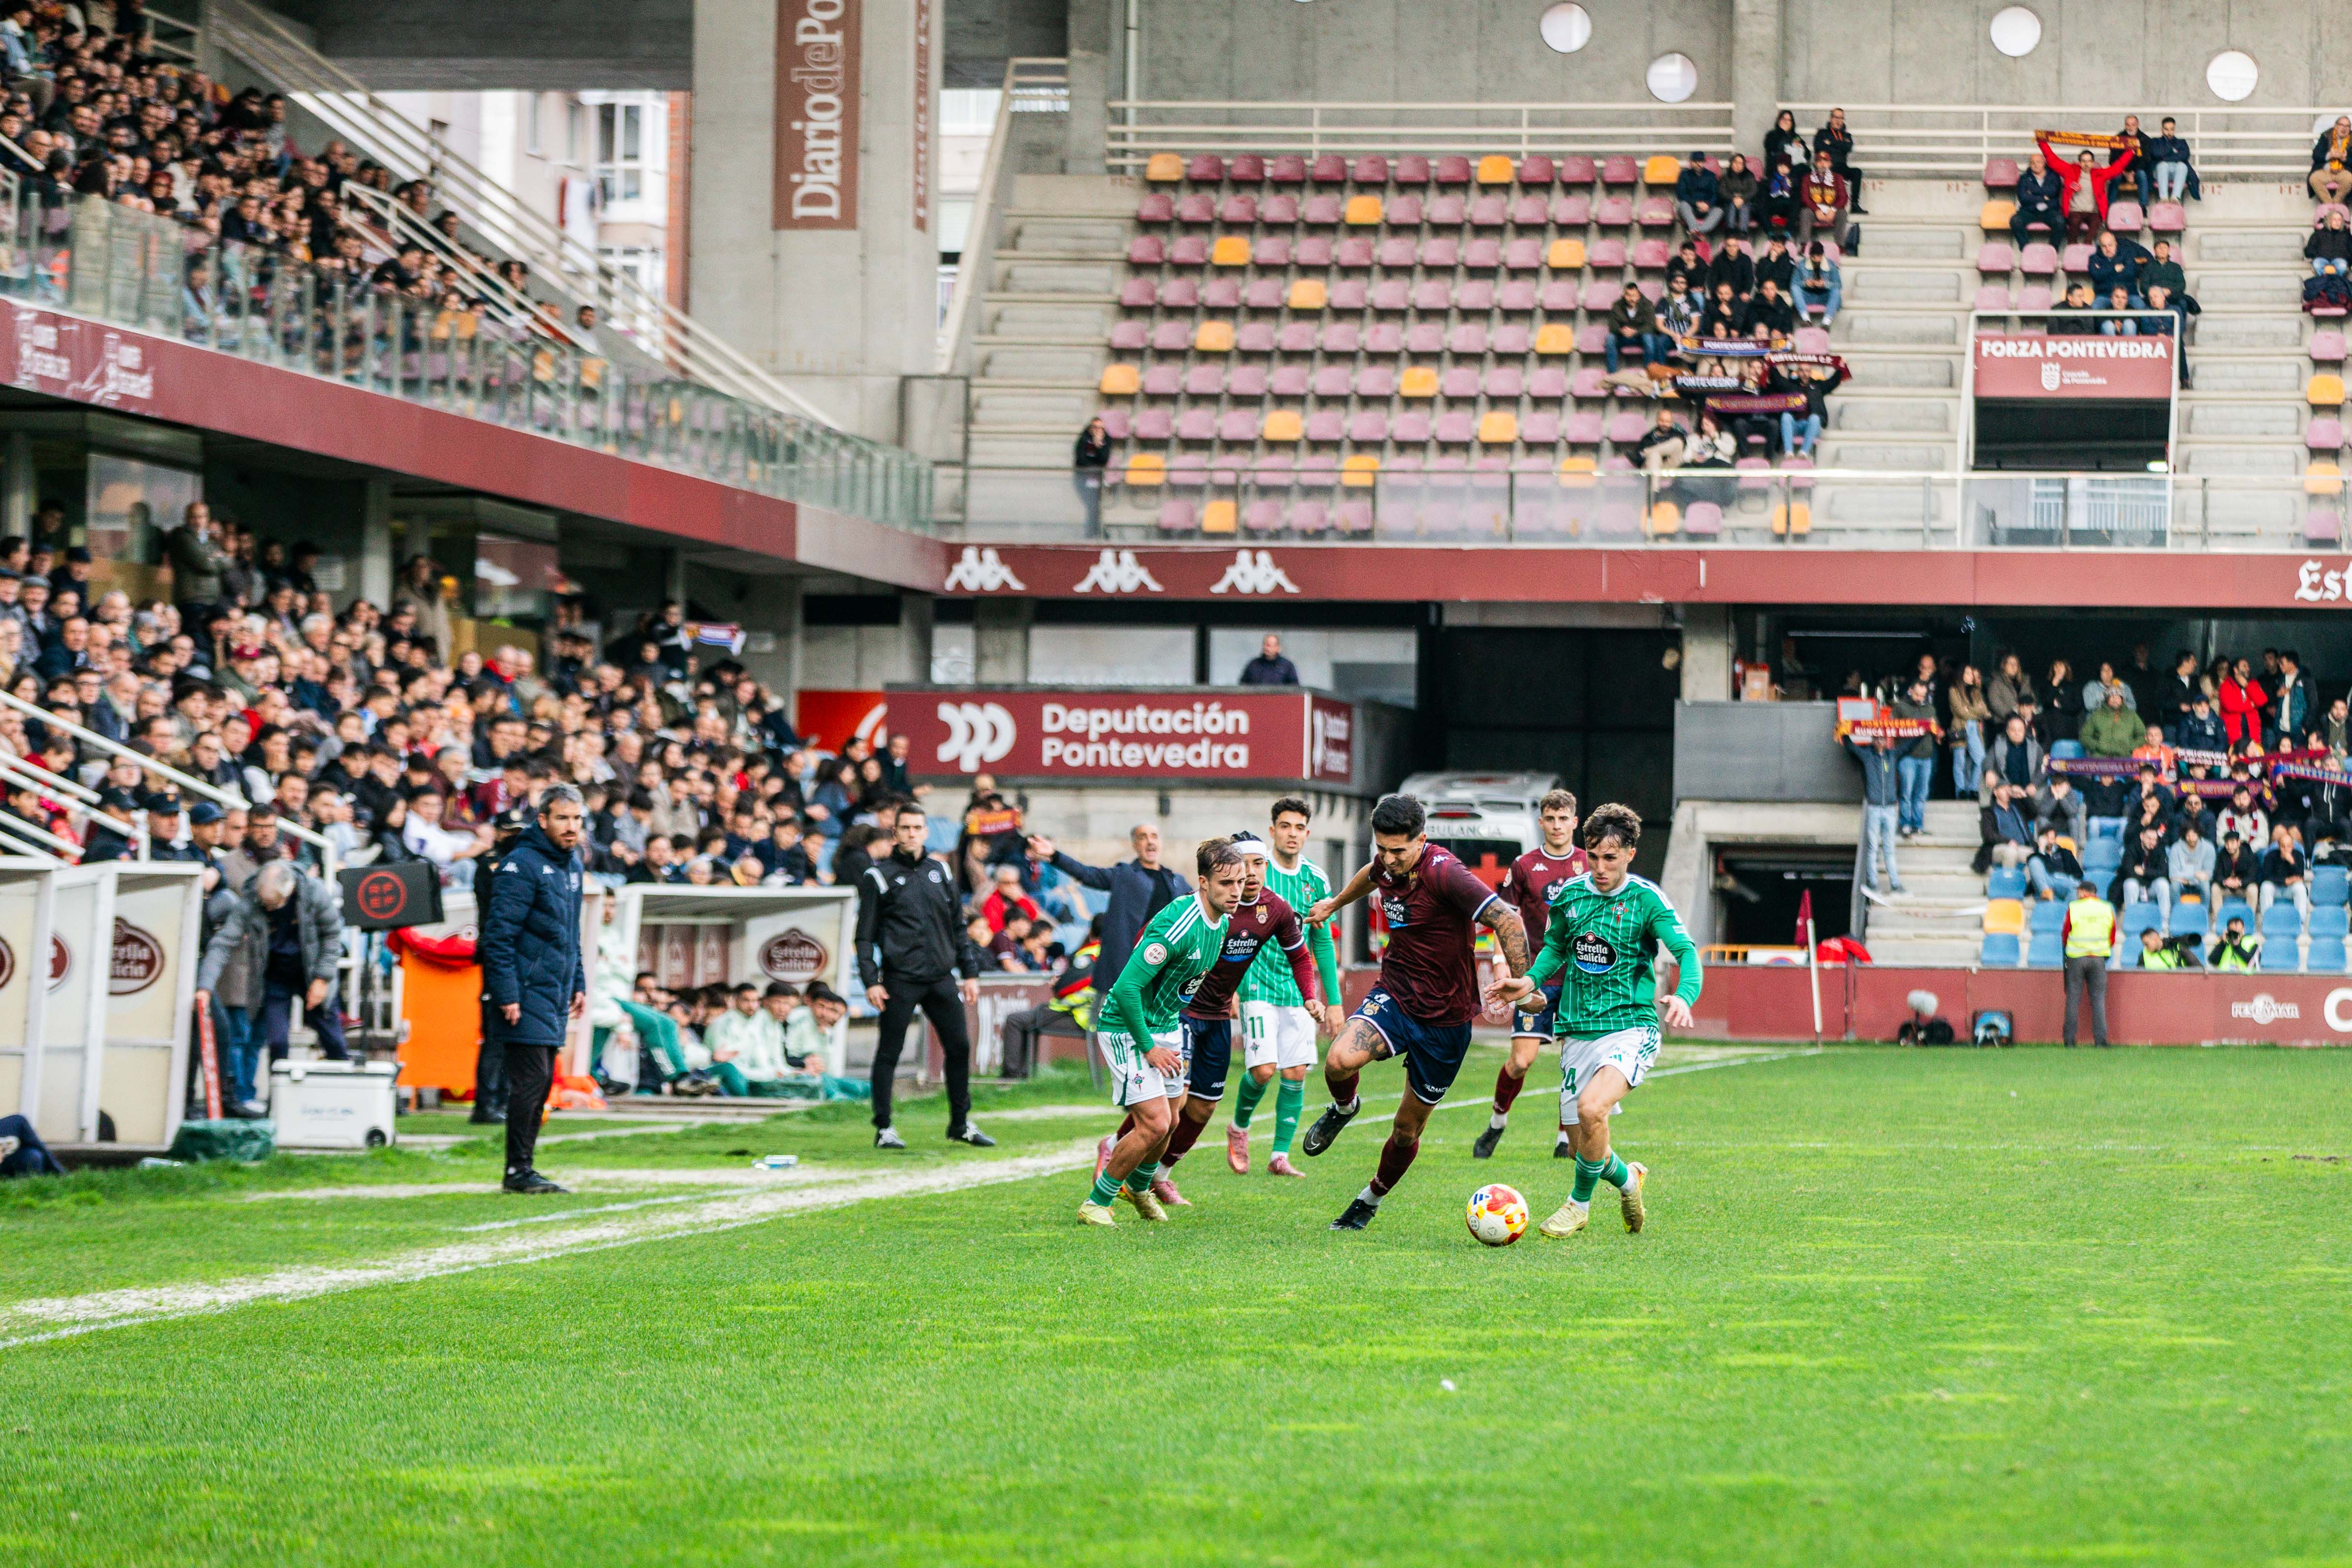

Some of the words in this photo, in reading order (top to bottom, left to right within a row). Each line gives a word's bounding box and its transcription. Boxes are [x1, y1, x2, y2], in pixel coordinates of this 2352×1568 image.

[1981, 340, 2043, 358] FORZA
[2046, 340, 2167, 359] PONTEVEDRA
[1041, 701, 1250, 742] Deputación
[1855, 727, 1883, 737] NUNCA
[1886, 727, 1896, 737] SE
[1041, 737, 1250, 768] Pontevedra
[1427, 824, 1502, 837] BULANCIA
[1226, 938, 1258, 947] Estrella
[1576, 941, 1608, 954] Estrella
[772, 945, 818, 958] Estrella
[1577, 951, 1607, 964] Galicia
[1249, 1016, 1264, 1039] 11
[1560, 1067, 1577, 1095] 4
